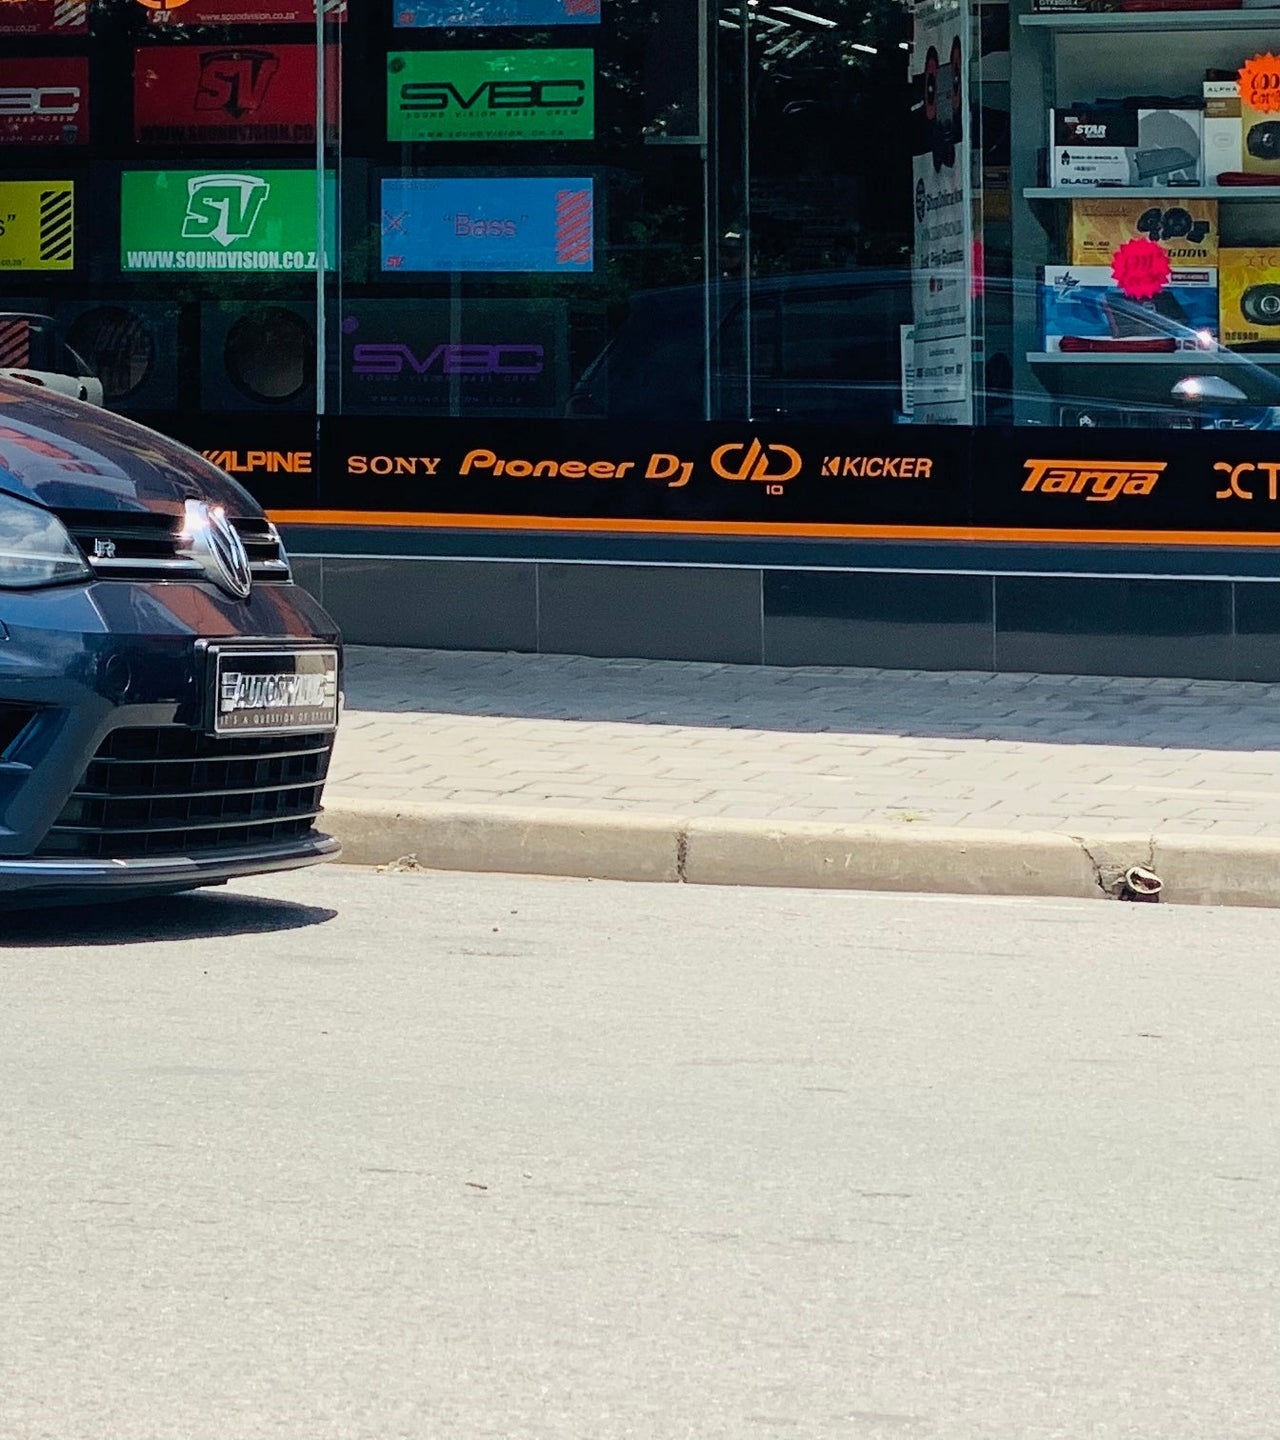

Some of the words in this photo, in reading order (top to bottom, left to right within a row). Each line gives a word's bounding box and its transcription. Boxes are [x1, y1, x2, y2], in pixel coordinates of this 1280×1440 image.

[400, 80, 585, 110] SVBC
[1075, 125, 1107, 135] STAR
[182, 183, 270, 238] SV
[216, 450, 312, 473] ALPINE
[348, 455, 441, 475] SONY
[459, 449, 634, 479] Pioneer
[842, 456, 933, 478] KICKER
[1021, 458, 1167, 502] Targa
